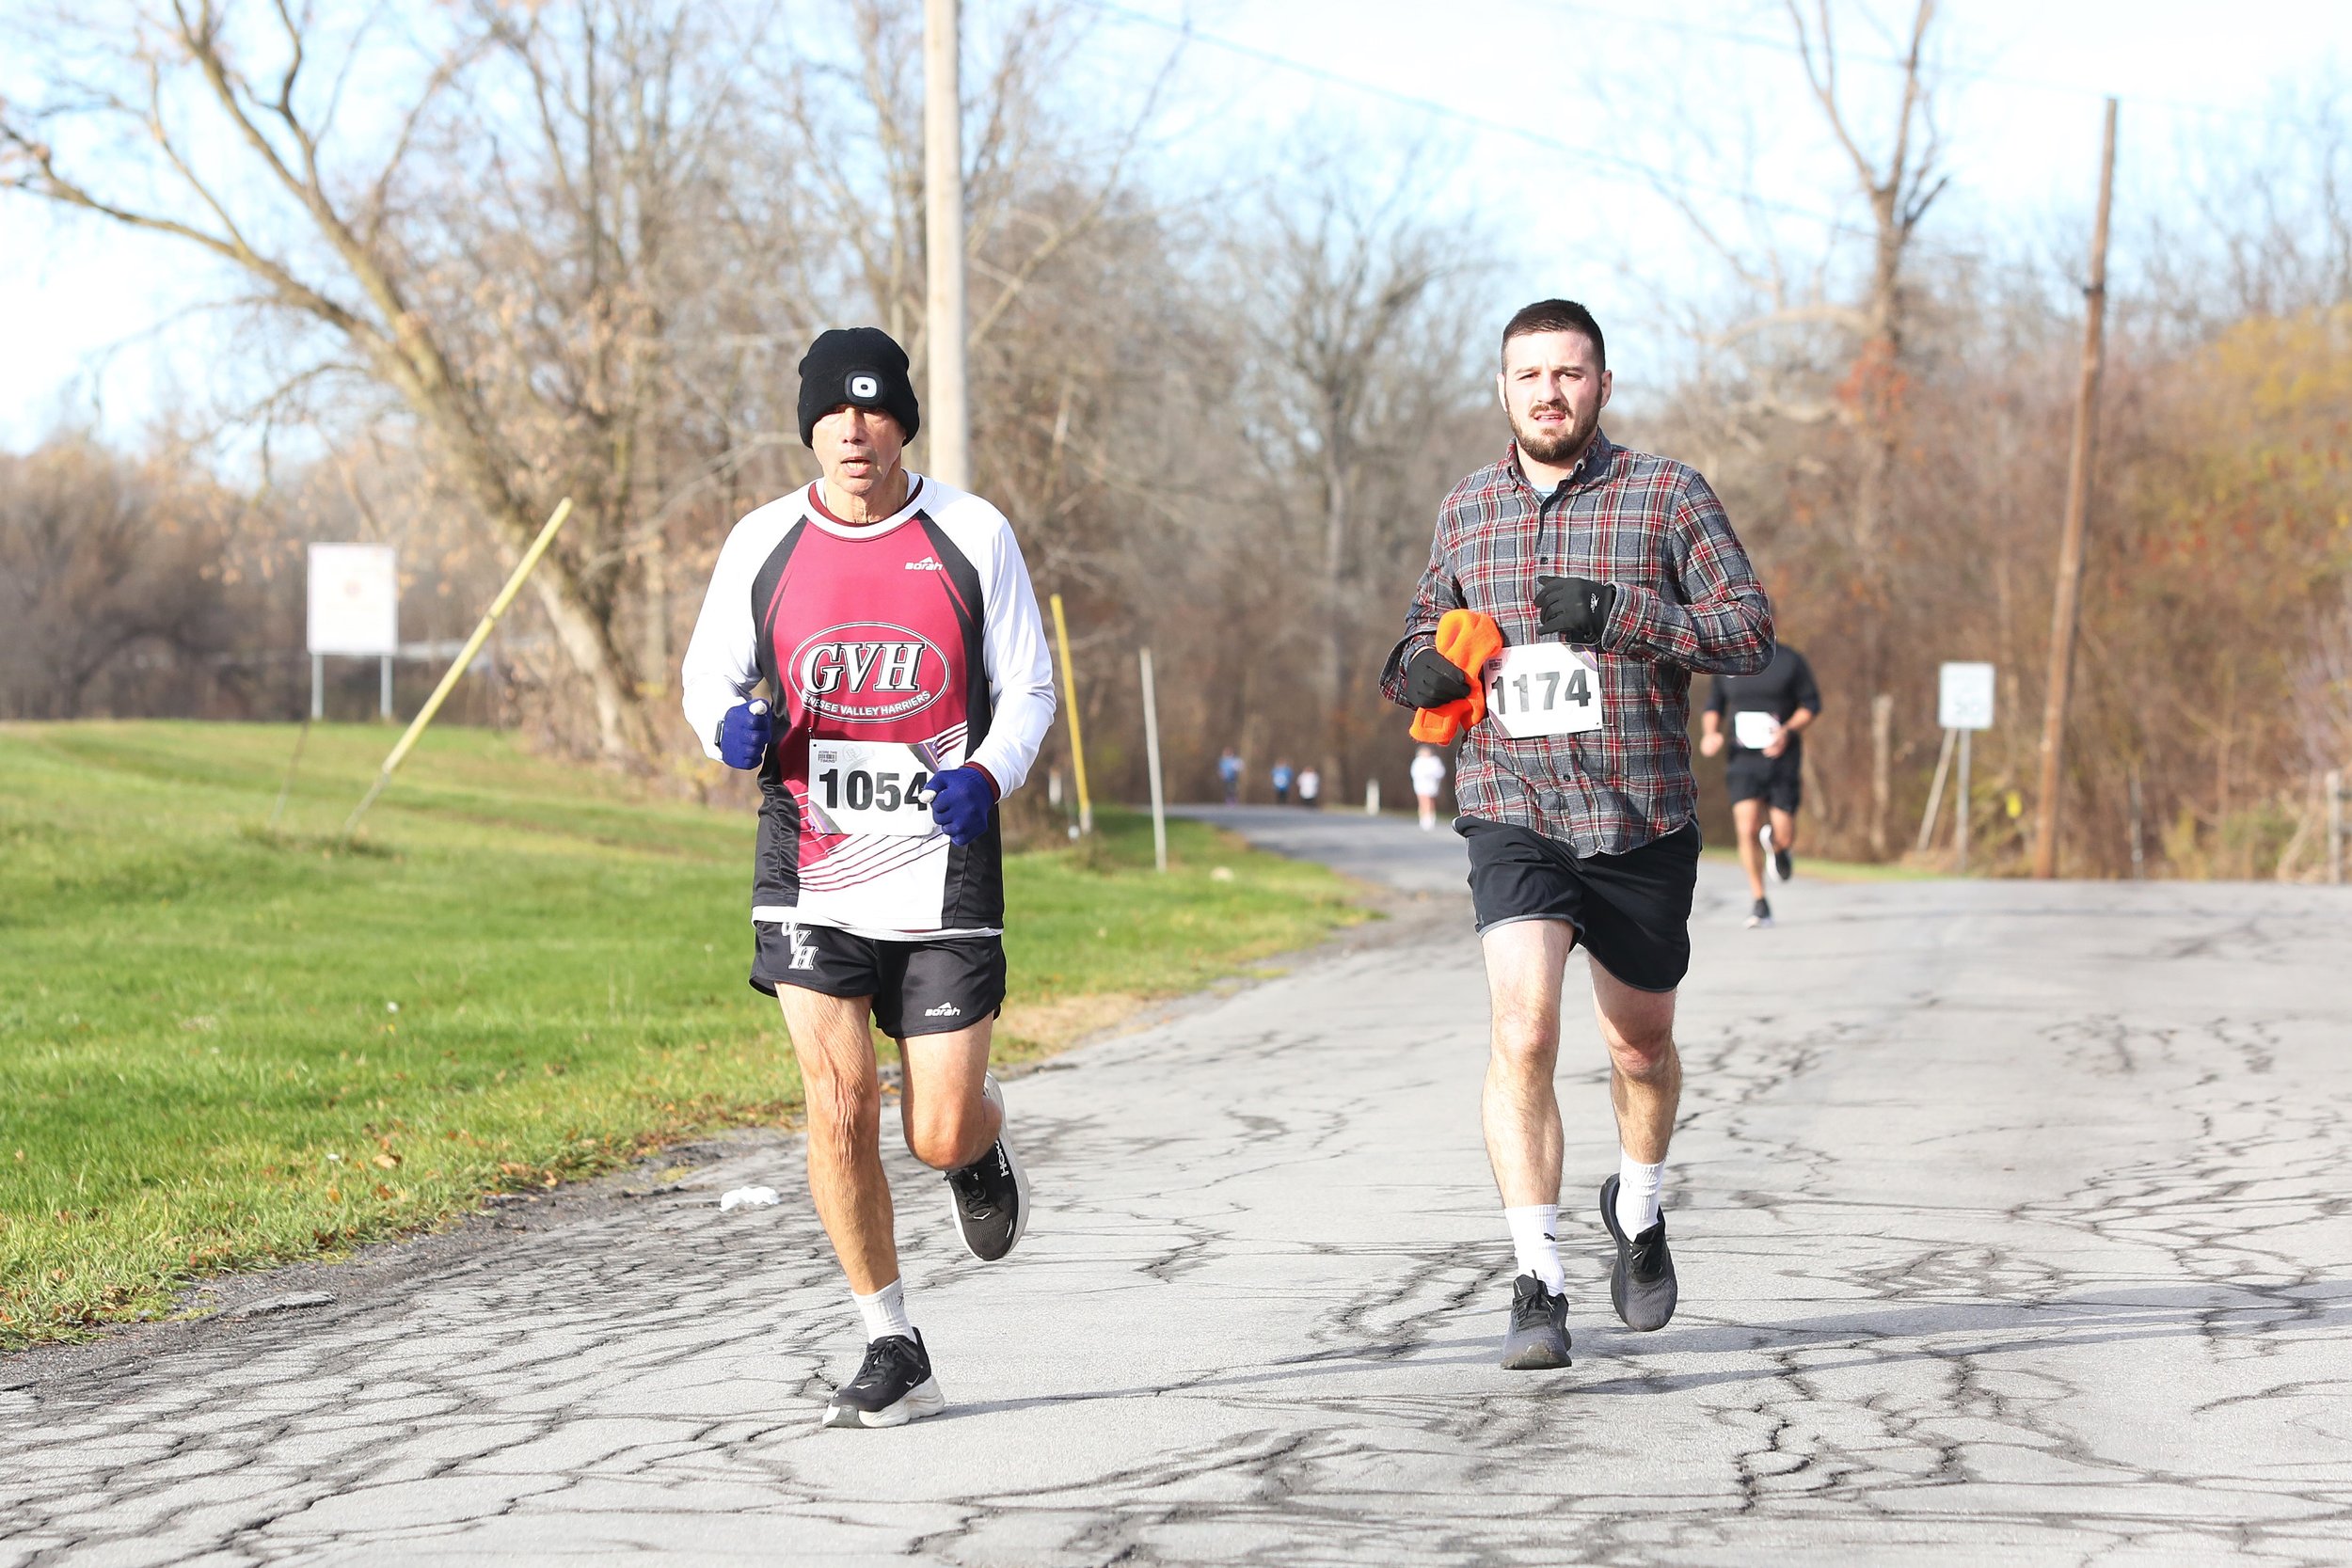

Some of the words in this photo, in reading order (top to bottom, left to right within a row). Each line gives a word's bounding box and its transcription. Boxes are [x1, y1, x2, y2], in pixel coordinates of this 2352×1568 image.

[801, 641, 927, 695] GVH
[840, 705, 880, 716] VALLEY
[880, 690, 930, 715] HARRIERS
[1491, 669, 1592, 715] 1174
[818, 768, 928, 812] 1054
